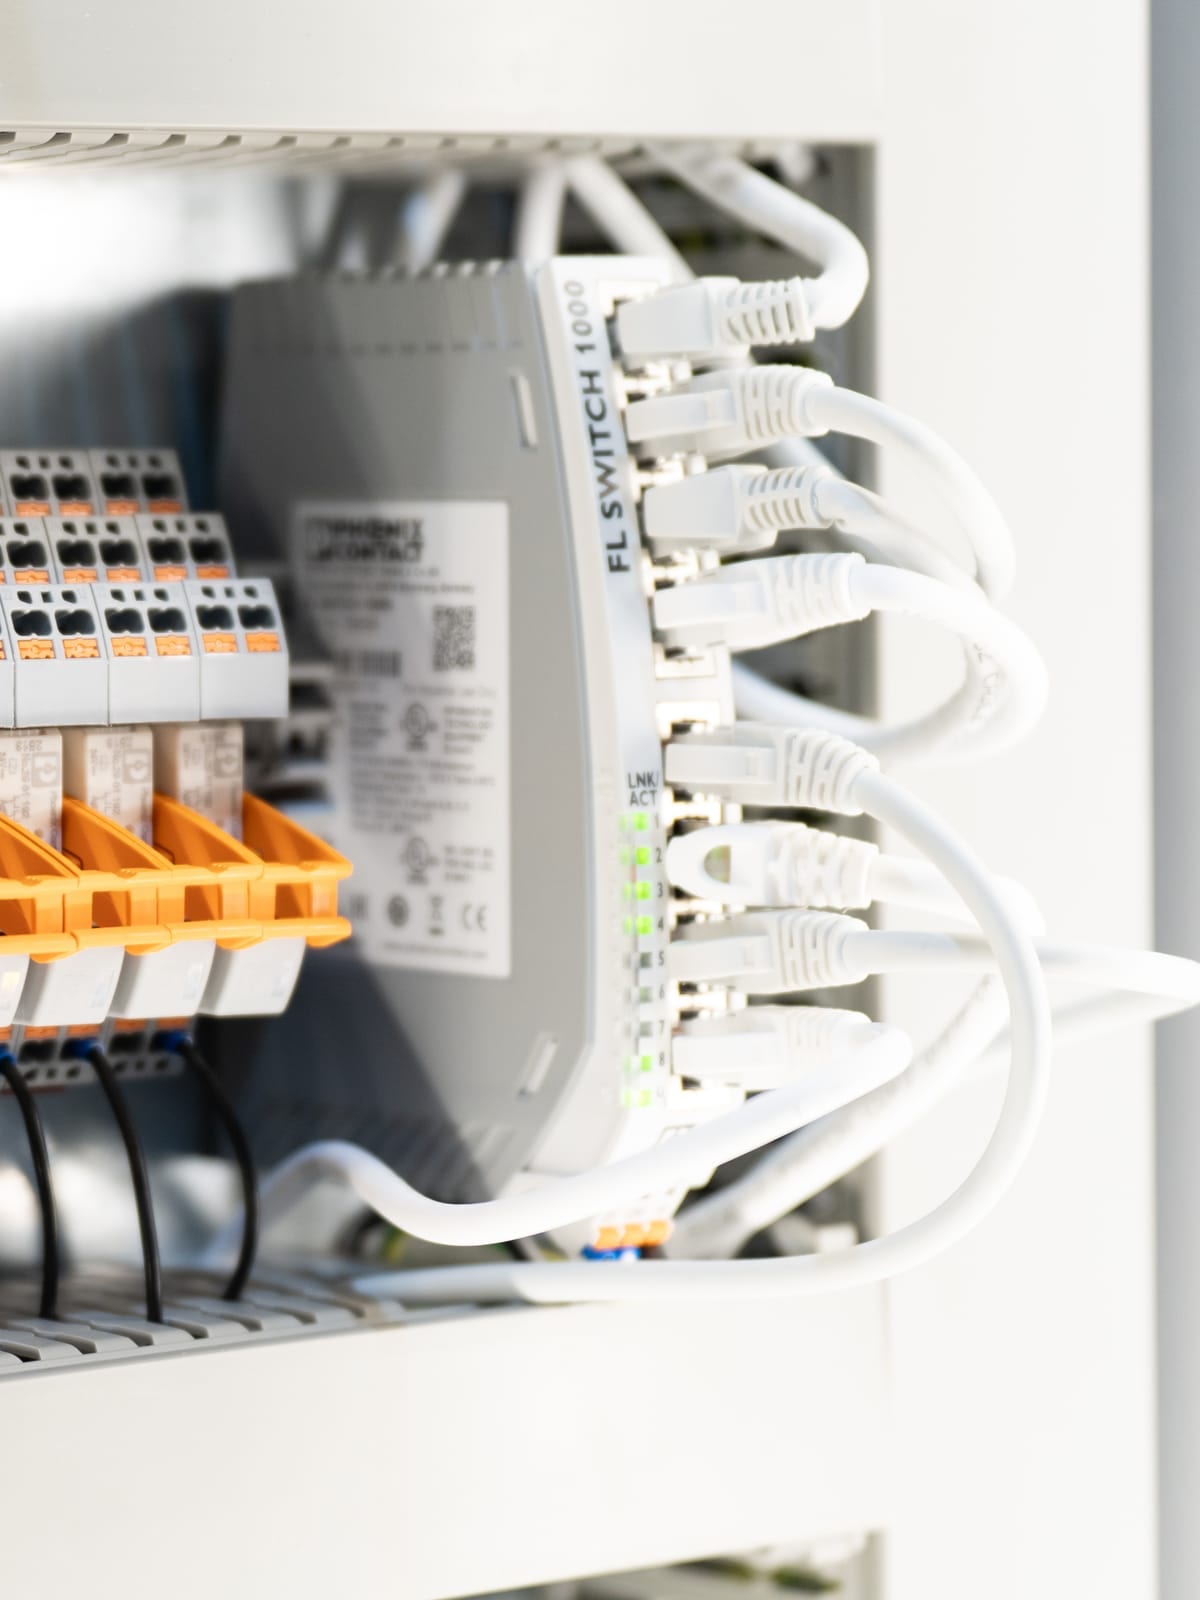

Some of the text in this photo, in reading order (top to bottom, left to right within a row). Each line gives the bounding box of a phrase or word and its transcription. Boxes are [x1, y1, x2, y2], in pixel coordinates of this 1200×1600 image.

[563, 280, 630, 573] FL SWITCH 1000
[628, 772, 659, 789] LNK/
[630, 790, 657, 806] ACT
[656, 848, 663, 863] 2
[657, 882, 664, 898] 3
[657, 916, 664, 932] 4
[658, 950, 665, 966] 5
[659, 984, 666, 1000] 6
[659, 1018, 666, 1034] 7
[659, 1052, 666, 1067] 8
